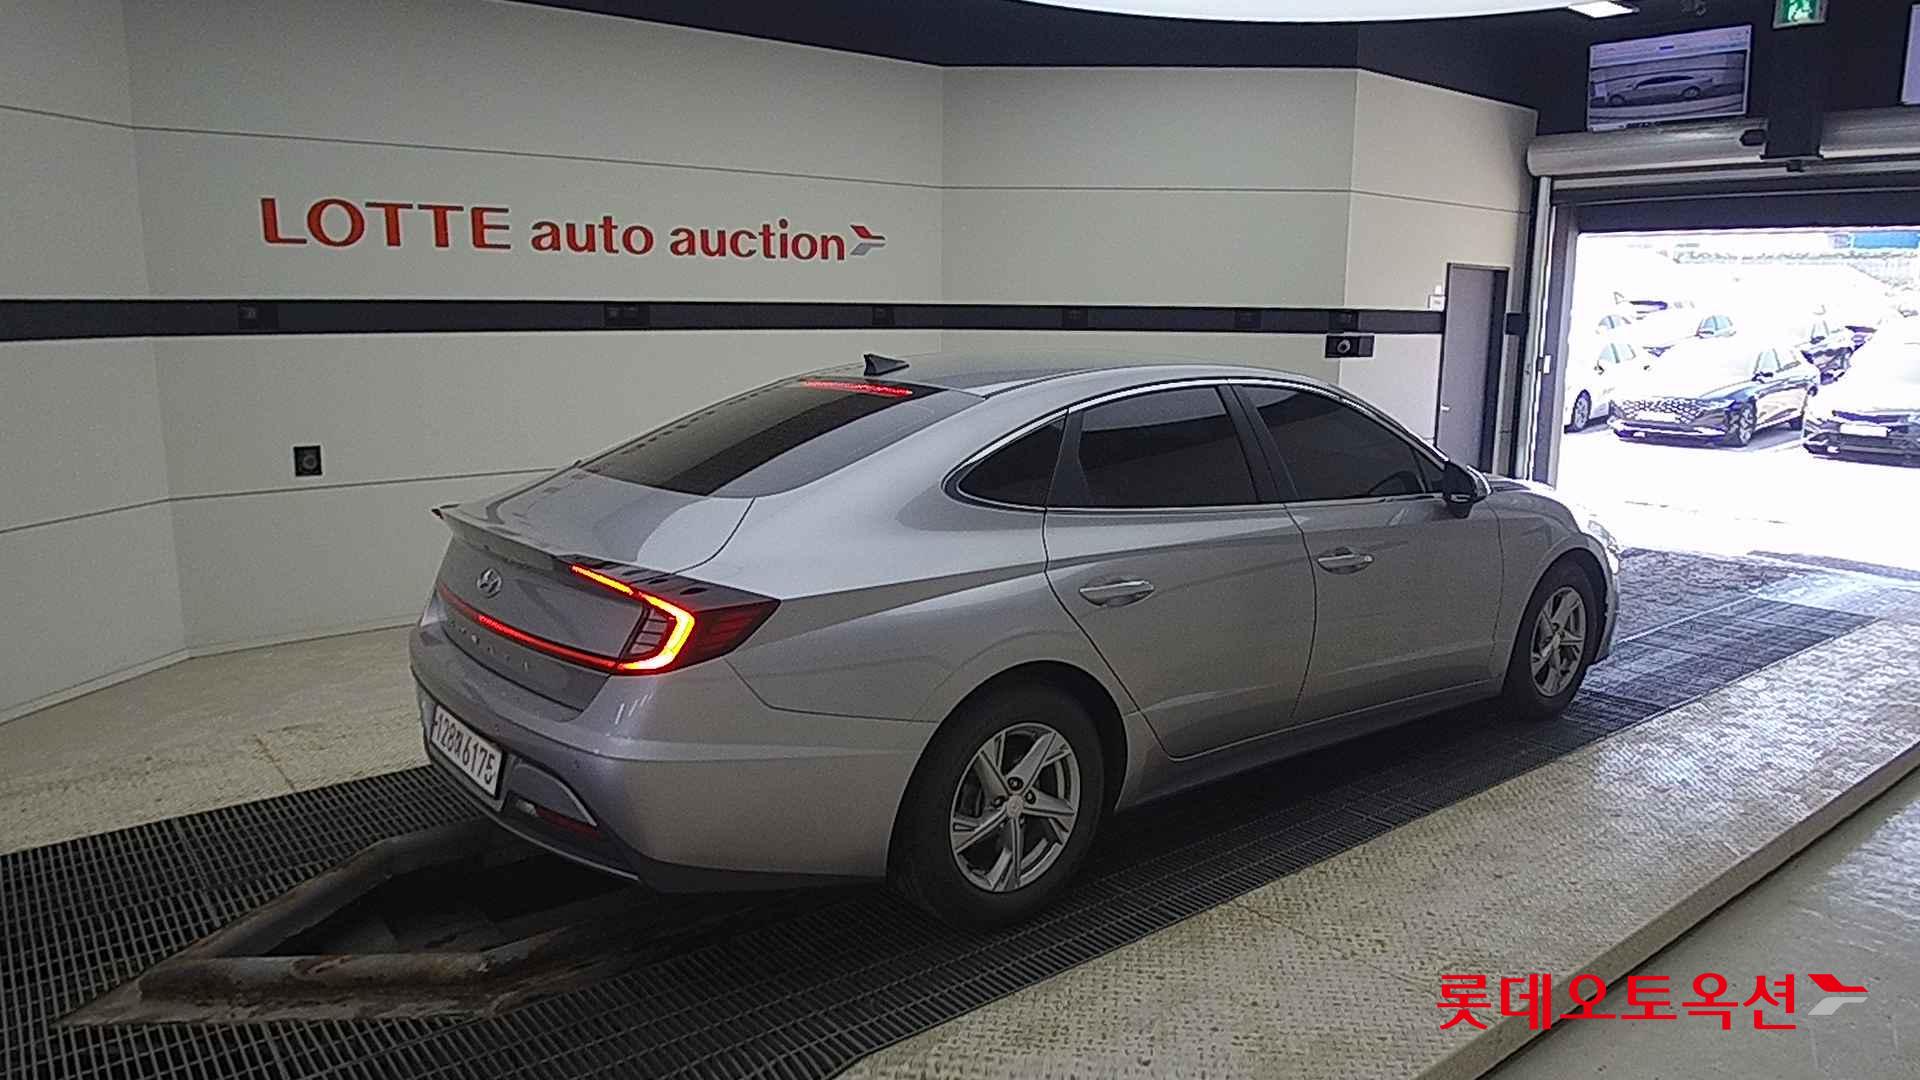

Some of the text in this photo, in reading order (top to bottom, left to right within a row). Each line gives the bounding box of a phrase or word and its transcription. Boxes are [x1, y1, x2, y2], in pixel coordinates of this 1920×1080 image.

[260, 197, 847, 260] LOTTE auto auction
